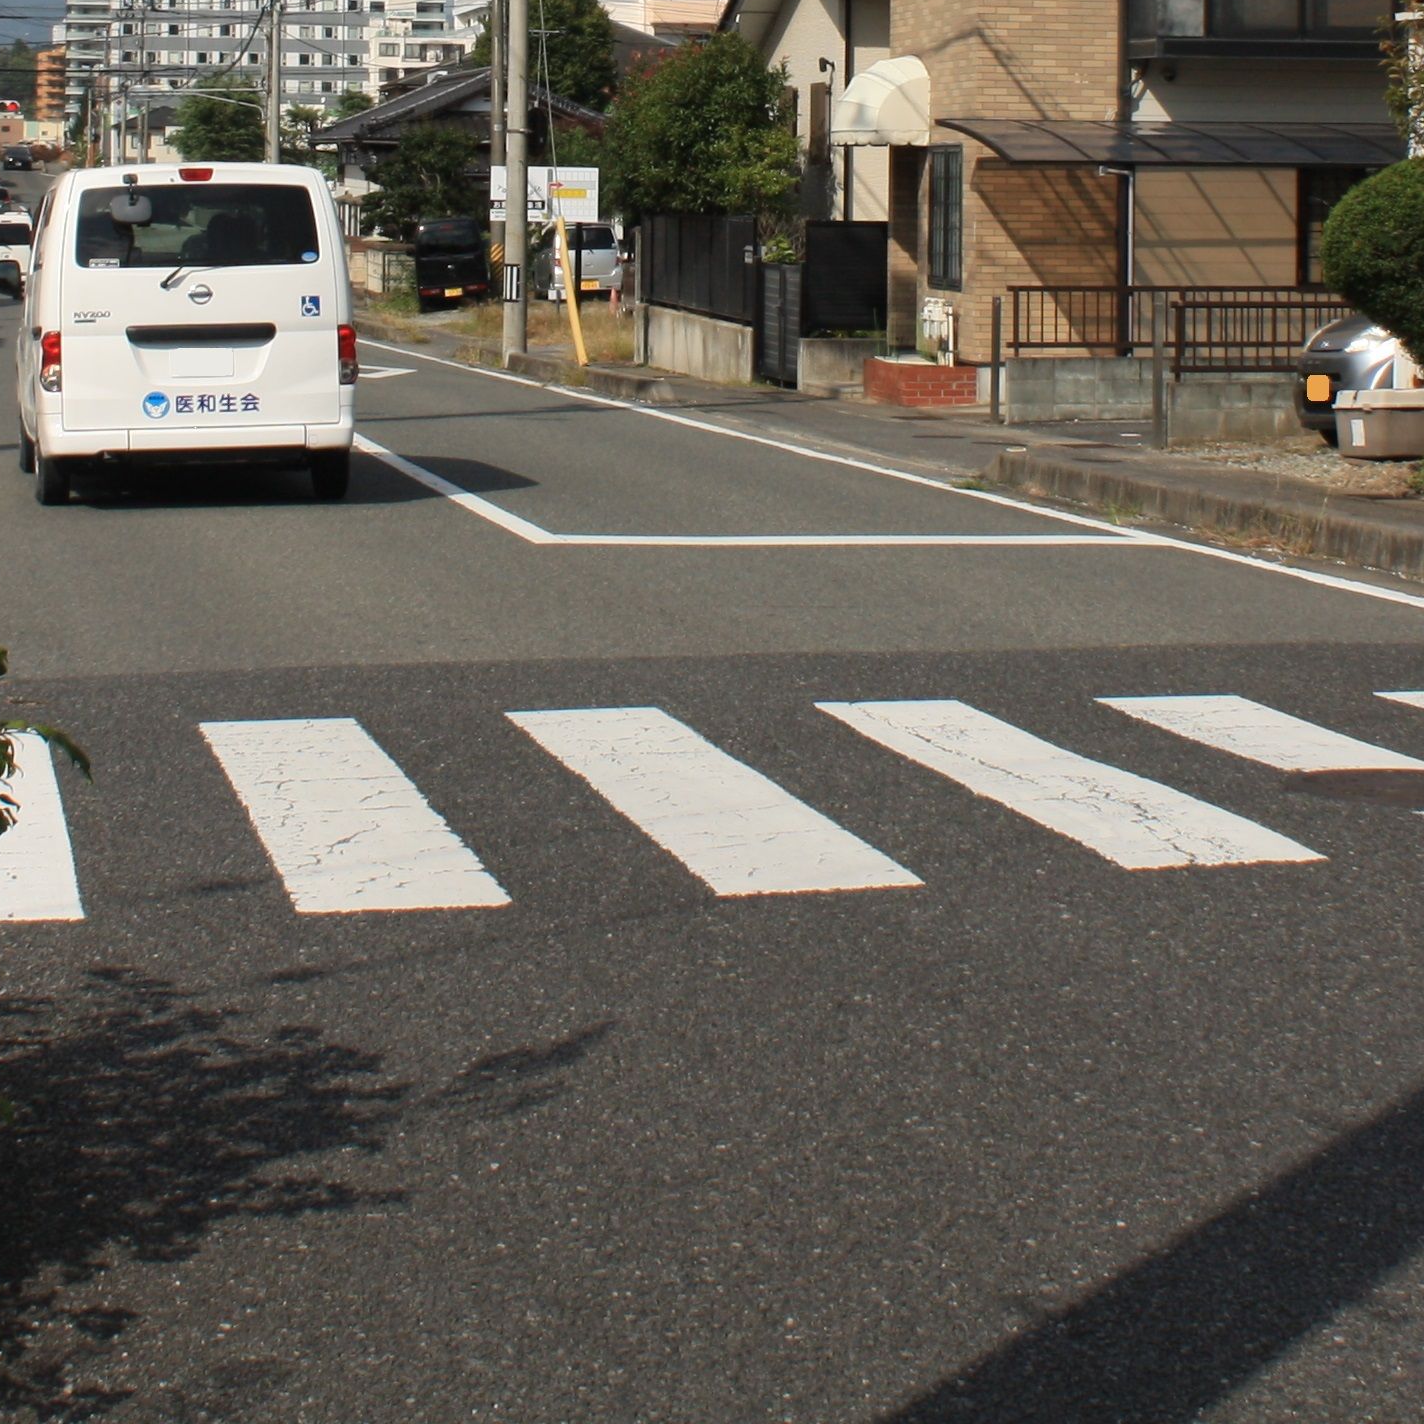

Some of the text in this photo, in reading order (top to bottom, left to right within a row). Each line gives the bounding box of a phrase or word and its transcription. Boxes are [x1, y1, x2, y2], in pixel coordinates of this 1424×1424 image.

[73, 310, 111, 319] NV200
[175, 393, 260, 414] 医和生会
